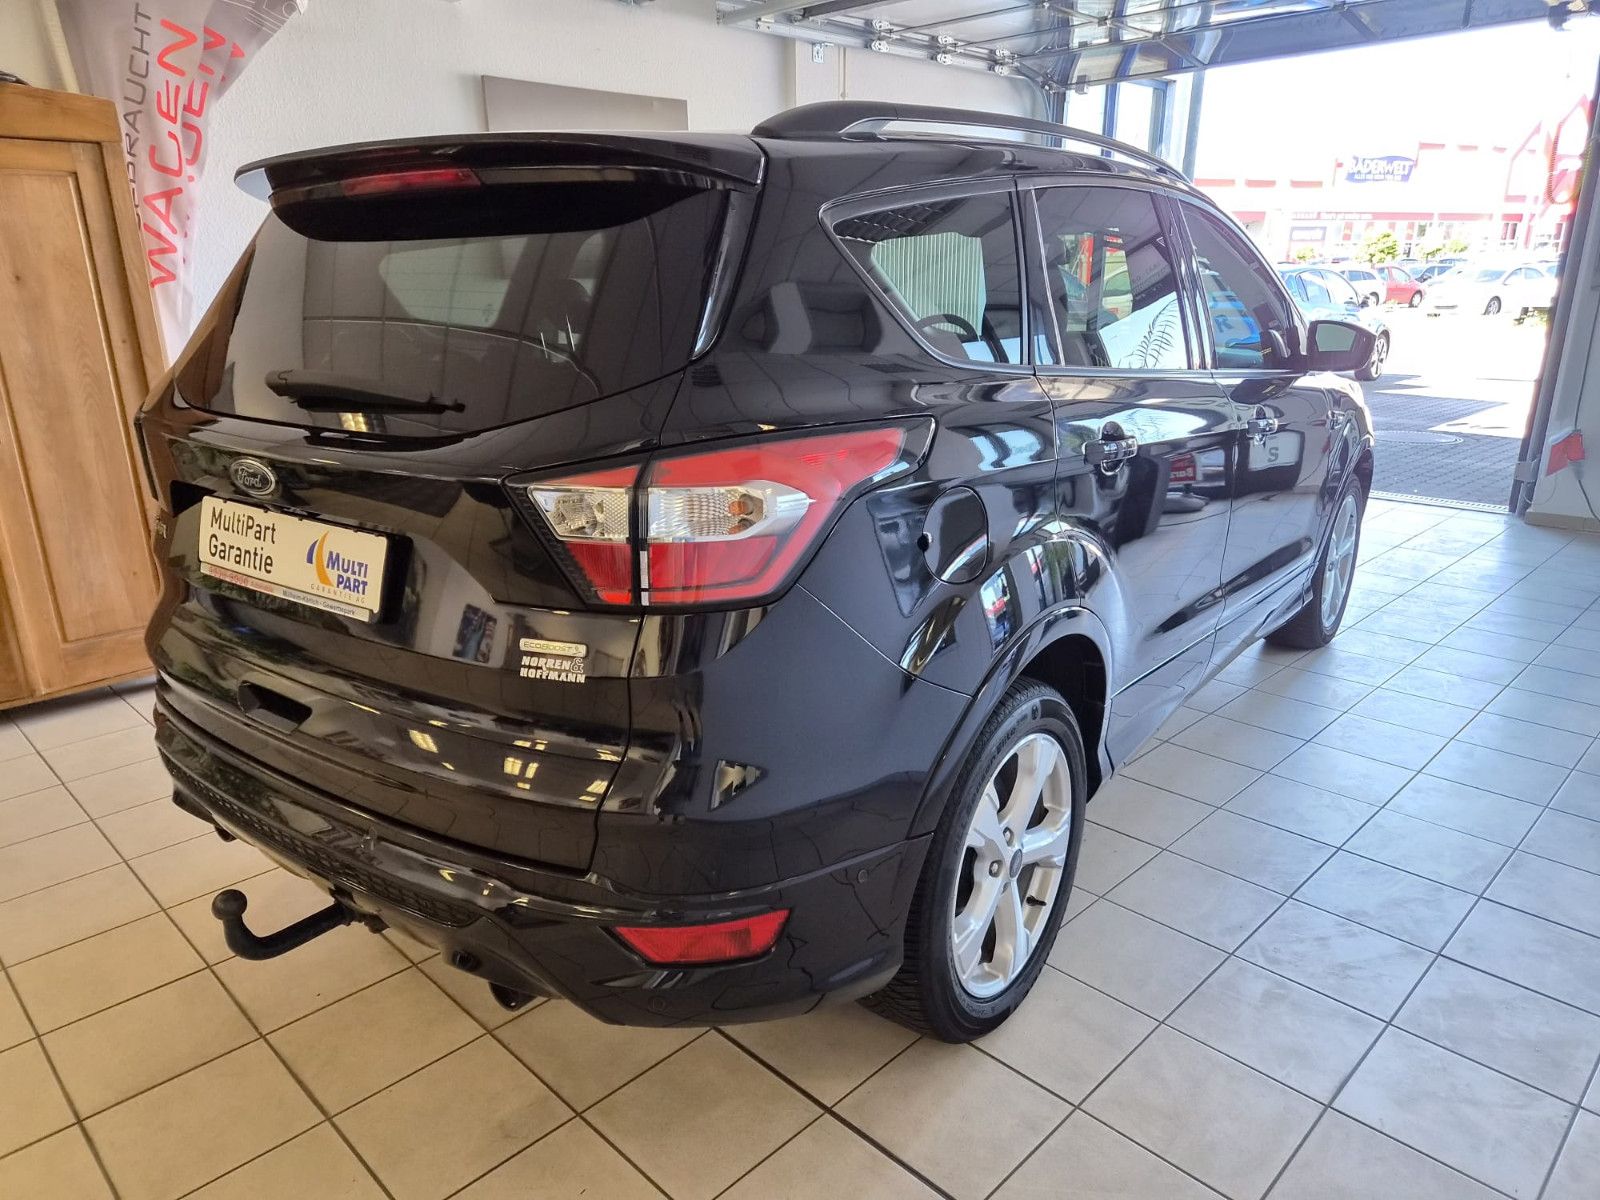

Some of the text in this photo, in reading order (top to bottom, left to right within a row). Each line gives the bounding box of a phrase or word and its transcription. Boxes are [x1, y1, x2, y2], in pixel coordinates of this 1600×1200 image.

[236, 466, 263, 488] Ford
[210, 506, 276, 544] MultiPart
[208, 534, 274, 574] Garantie
[326, 550, 368, 579] MULTI
[310, 583, 352, 601] GARANTIE
[336, 574, 368, 596] PART
[520, 667, 586, 683] HOFFMANN
